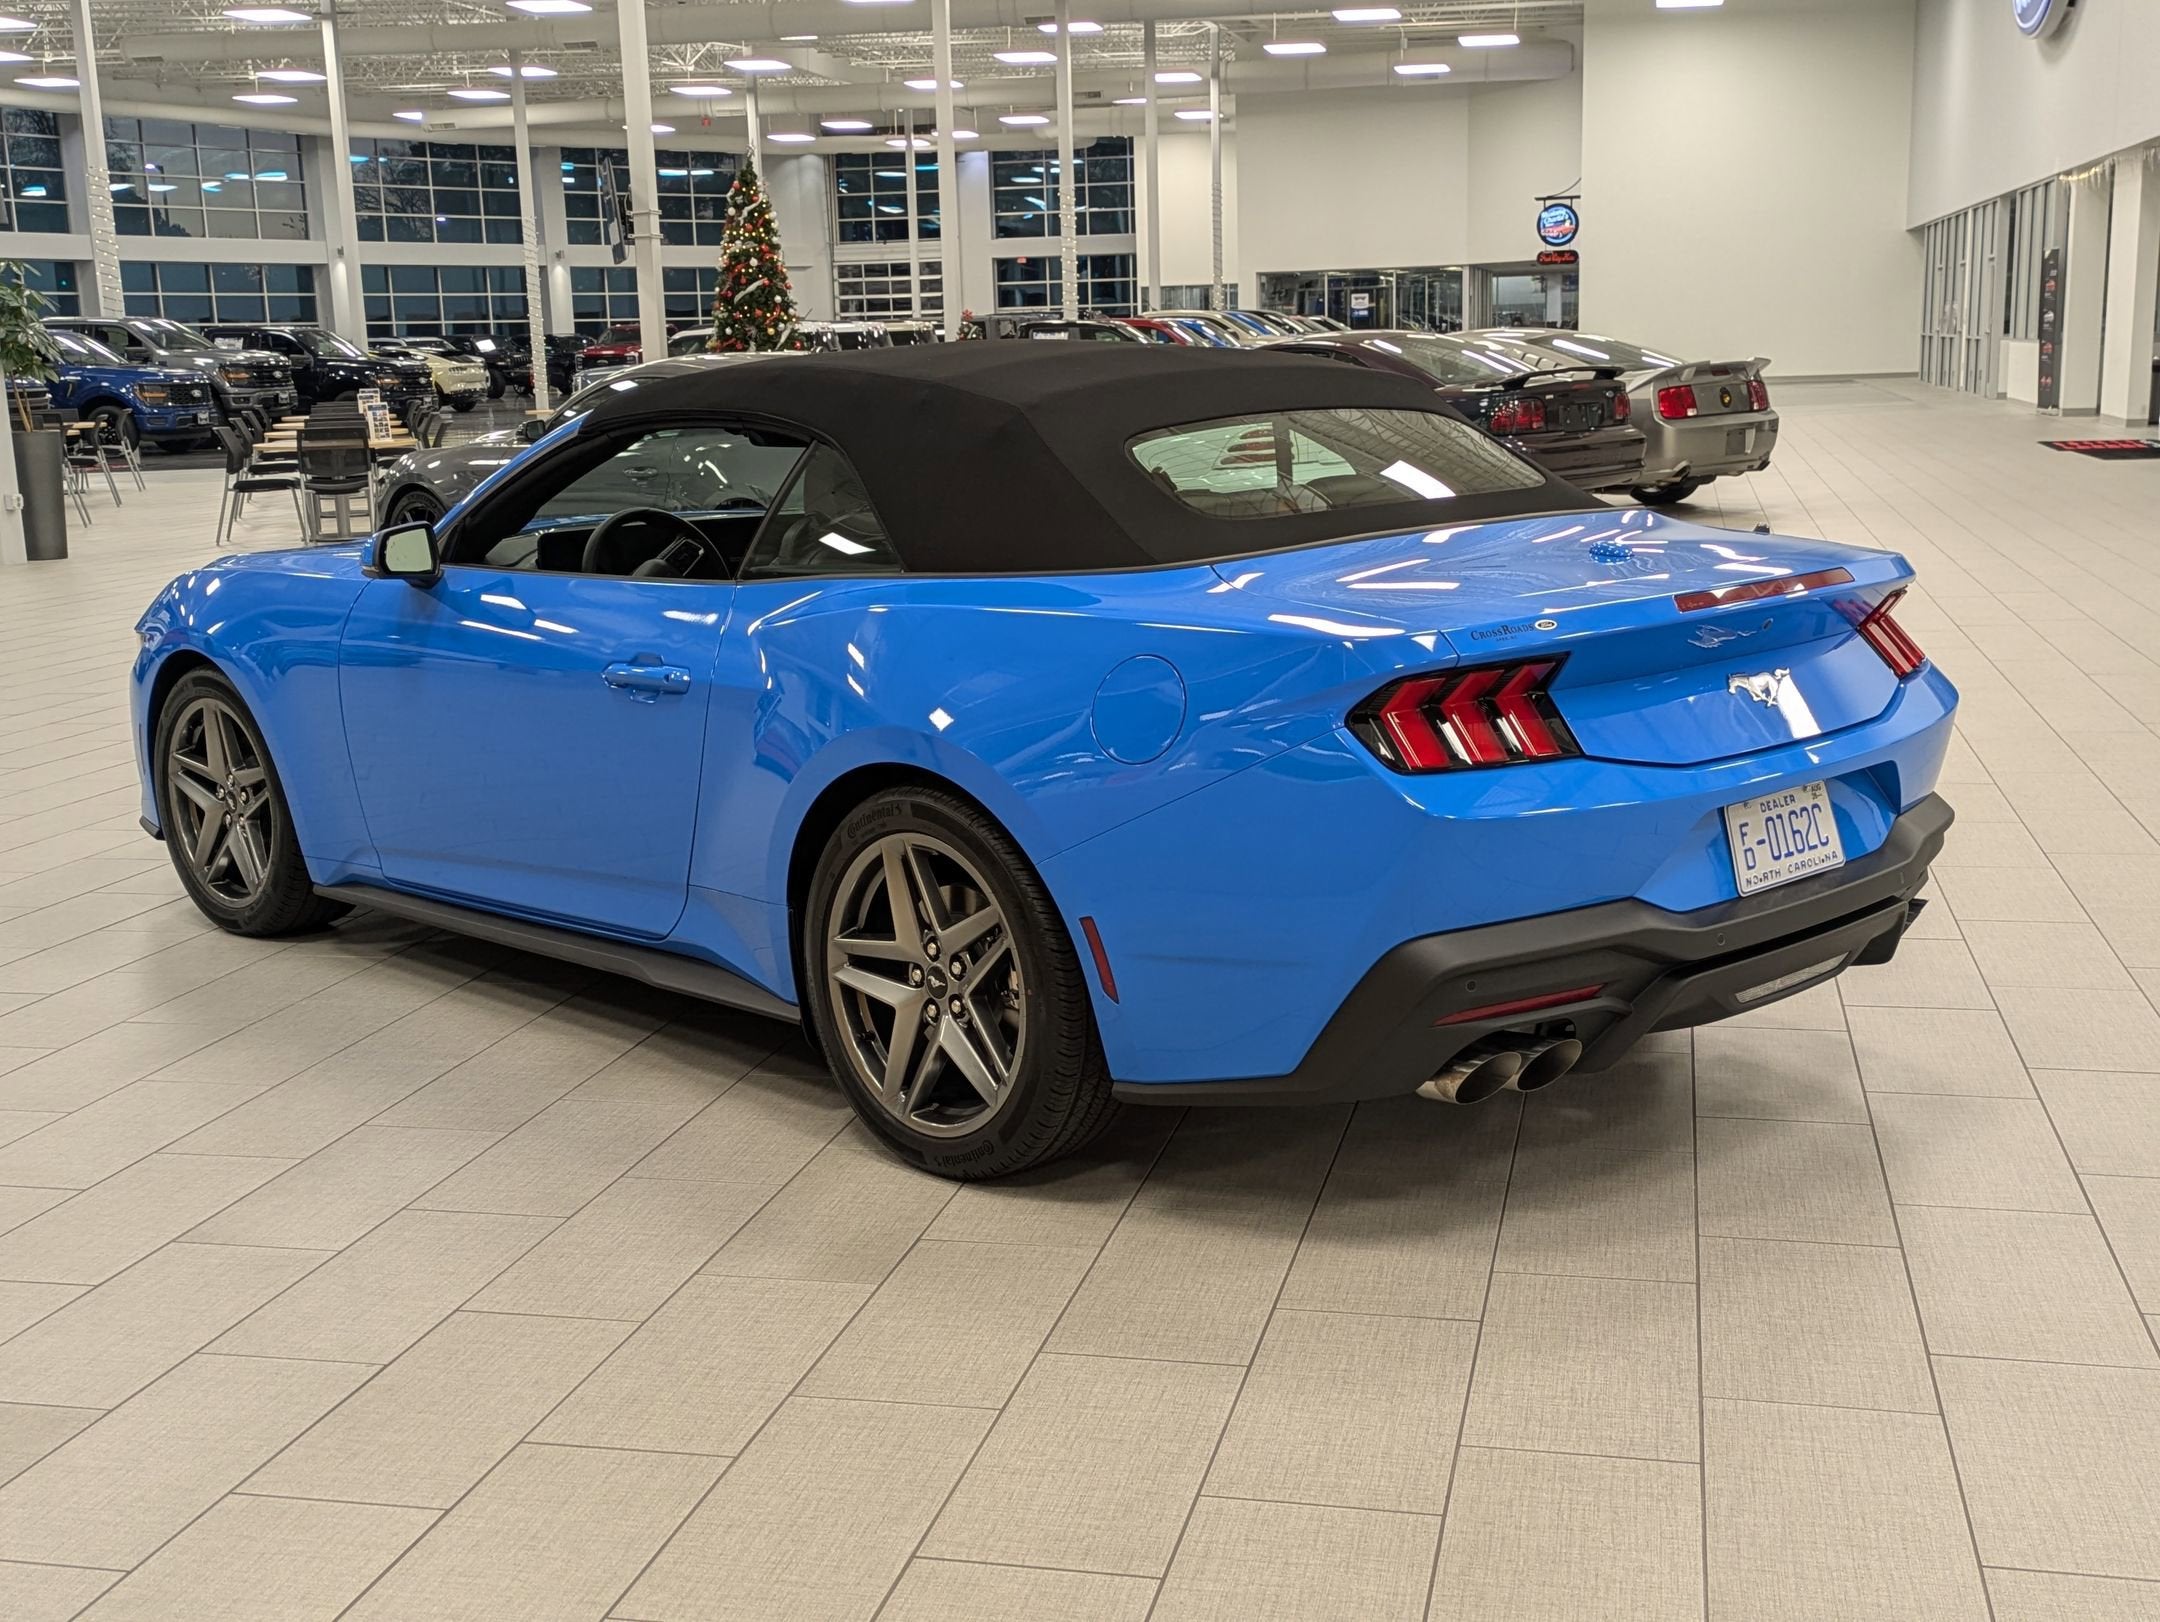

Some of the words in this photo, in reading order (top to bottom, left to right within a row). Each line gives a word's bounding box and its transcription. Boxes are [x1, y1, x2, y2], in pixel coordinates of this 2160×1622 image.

[1760, 794, 1796, 813] DEALER
[1746, 869, 1782, 888] NORTH
[1787, 850, 1838, 874] CAROLINA
